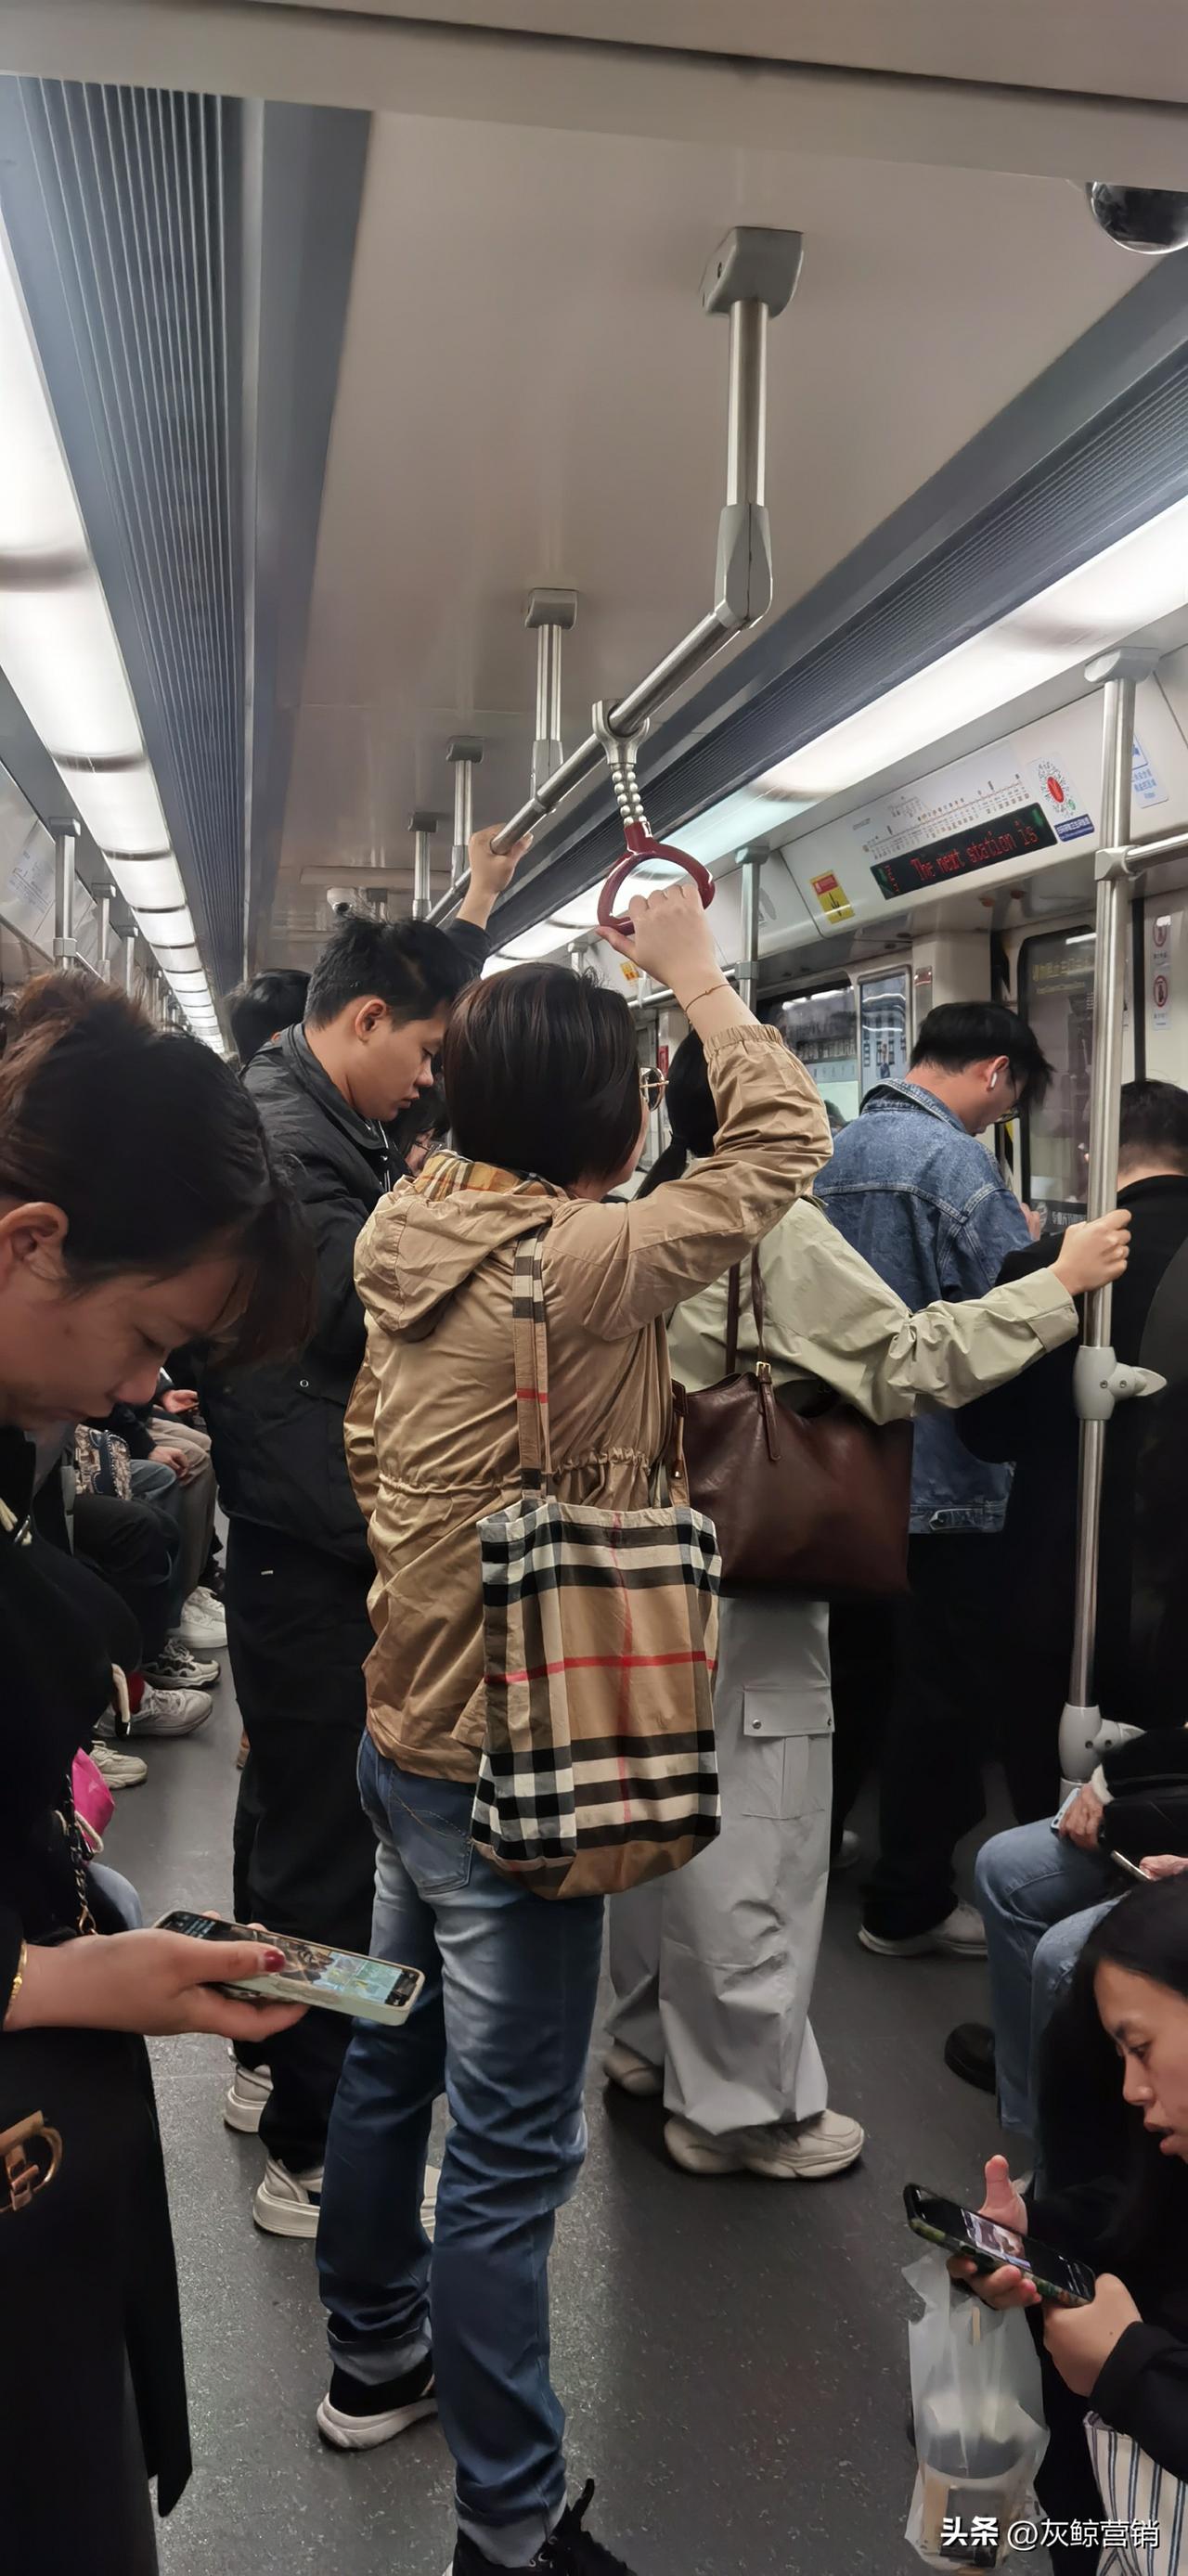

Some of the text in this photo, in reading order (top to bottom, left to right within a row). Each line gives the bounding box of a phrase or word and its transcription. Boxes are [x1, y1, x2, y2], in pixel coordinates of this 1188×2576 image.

[910, 857, 935, 881] The
[936, 849, 964, 873] next
[966, 831, 1015, 863] station
[1014, 820, 1040, 846] is
